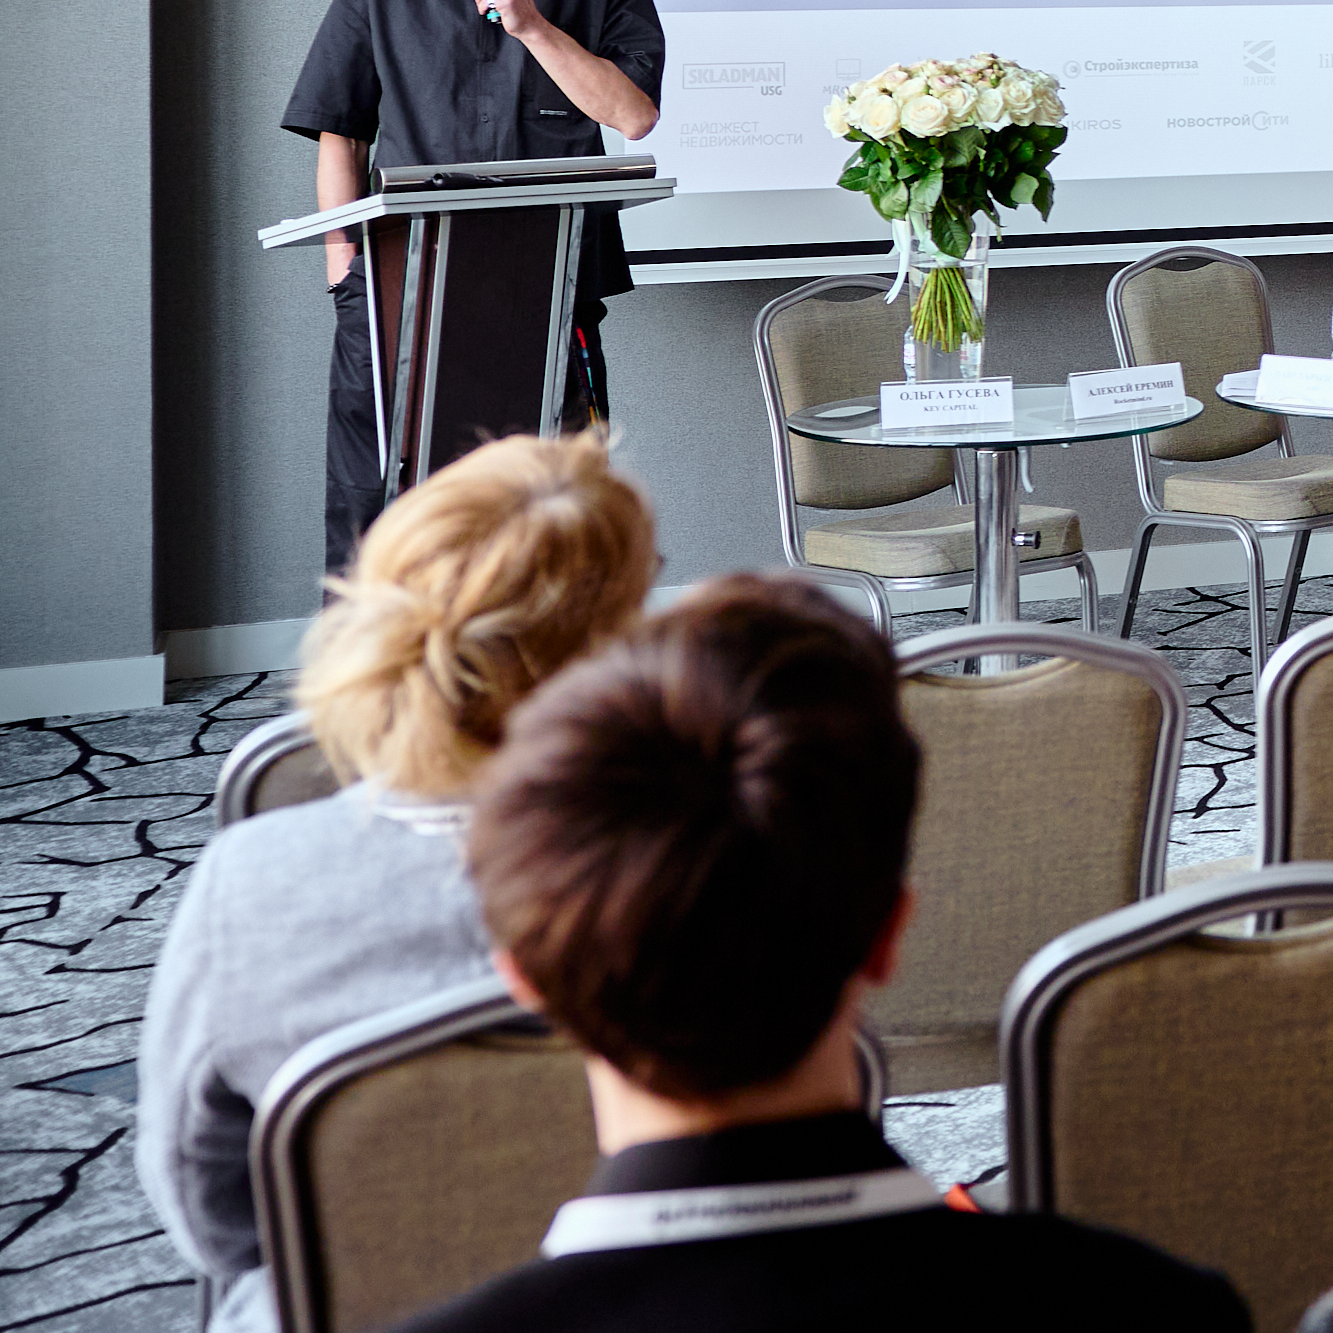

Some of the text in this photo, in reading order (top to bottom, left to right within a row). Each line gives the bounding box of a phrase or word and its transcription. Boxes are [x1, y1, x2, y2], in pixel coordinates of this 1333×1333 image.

[1084, 58, 1199, 72] Стройэкспертиза
[687, 66, 781, 84] SKLADMAN
[760, 84, 783, 96] USG
[680, 119, 760, 135] ДАЙДЖЕСТ
[680, 132, 803, 148] НЕДВИЖИМОСТИ
[900, 388, 1000, 402] ОЛЬГА ГУСЕВА
[1088, 379, 1174, 397] АЛЕКСЕЙ ЕРЕМИН
[942, 404, 978, 412] CAPITAL
